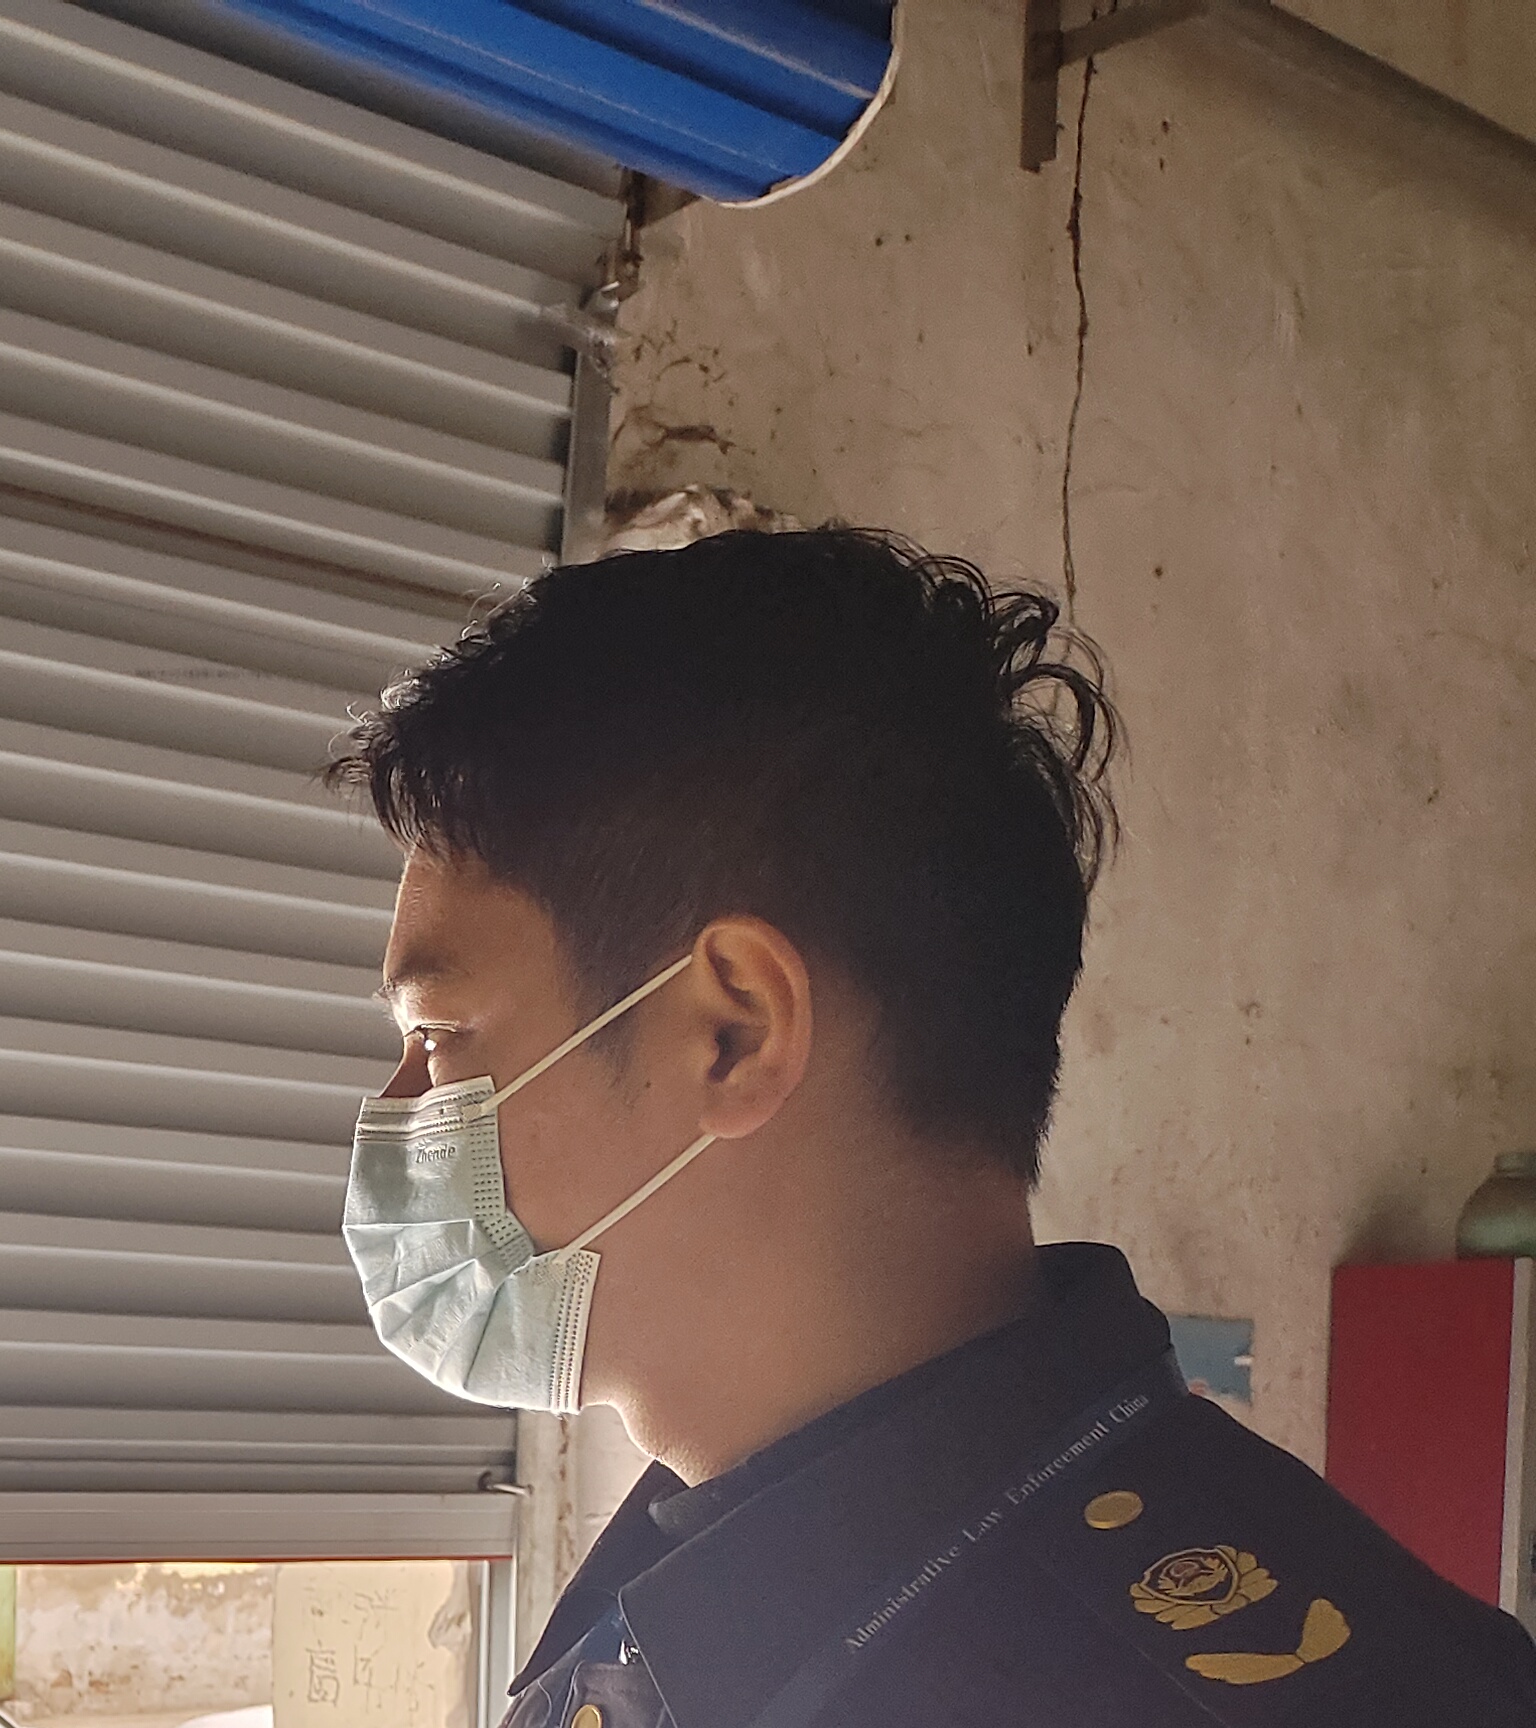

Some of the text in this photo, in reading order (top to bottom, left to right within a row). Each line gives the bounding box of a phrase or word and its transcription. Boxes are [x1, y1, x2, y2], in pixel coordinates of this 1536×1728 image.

[845, 1545, 959, 1653] Administrative
[961, 1509, 1003, 1543] Law
[1006, 1420, 1110, 1506] Enforcement
